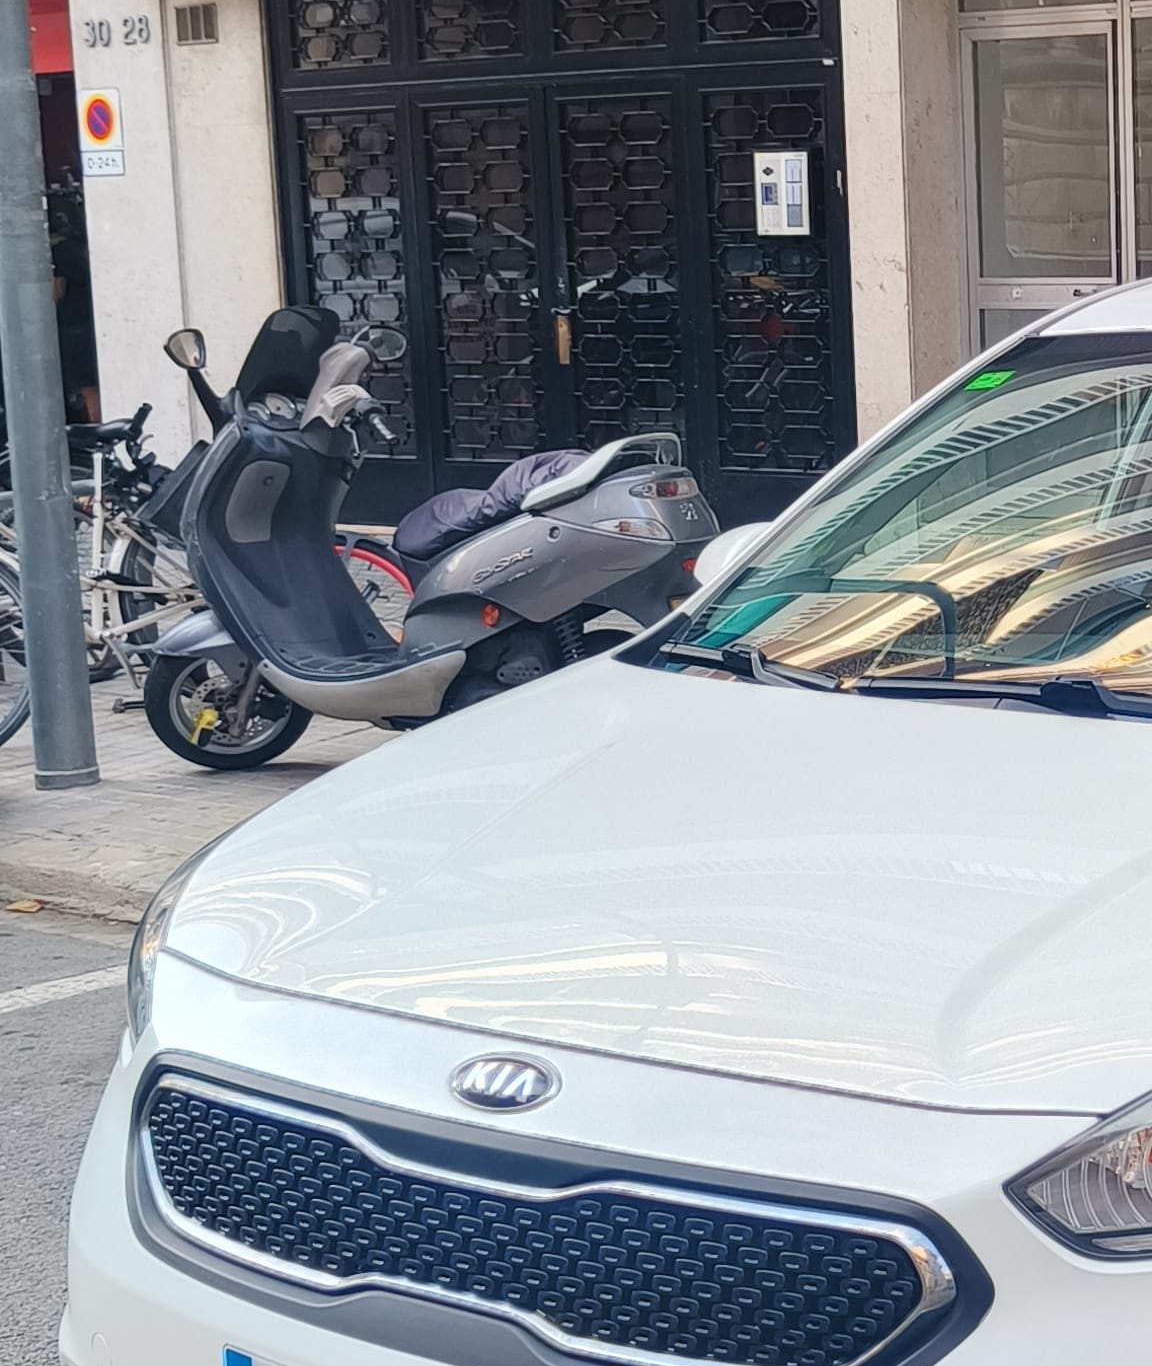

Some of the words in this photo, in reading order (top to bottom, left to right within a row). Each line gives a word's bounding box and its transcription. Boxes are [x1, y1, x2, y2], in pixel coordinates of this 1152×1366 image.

[84, 17, 112, 48] 30
[122, 14, 151, 46] 28
[460, 1059, 538, 1104] KIA
